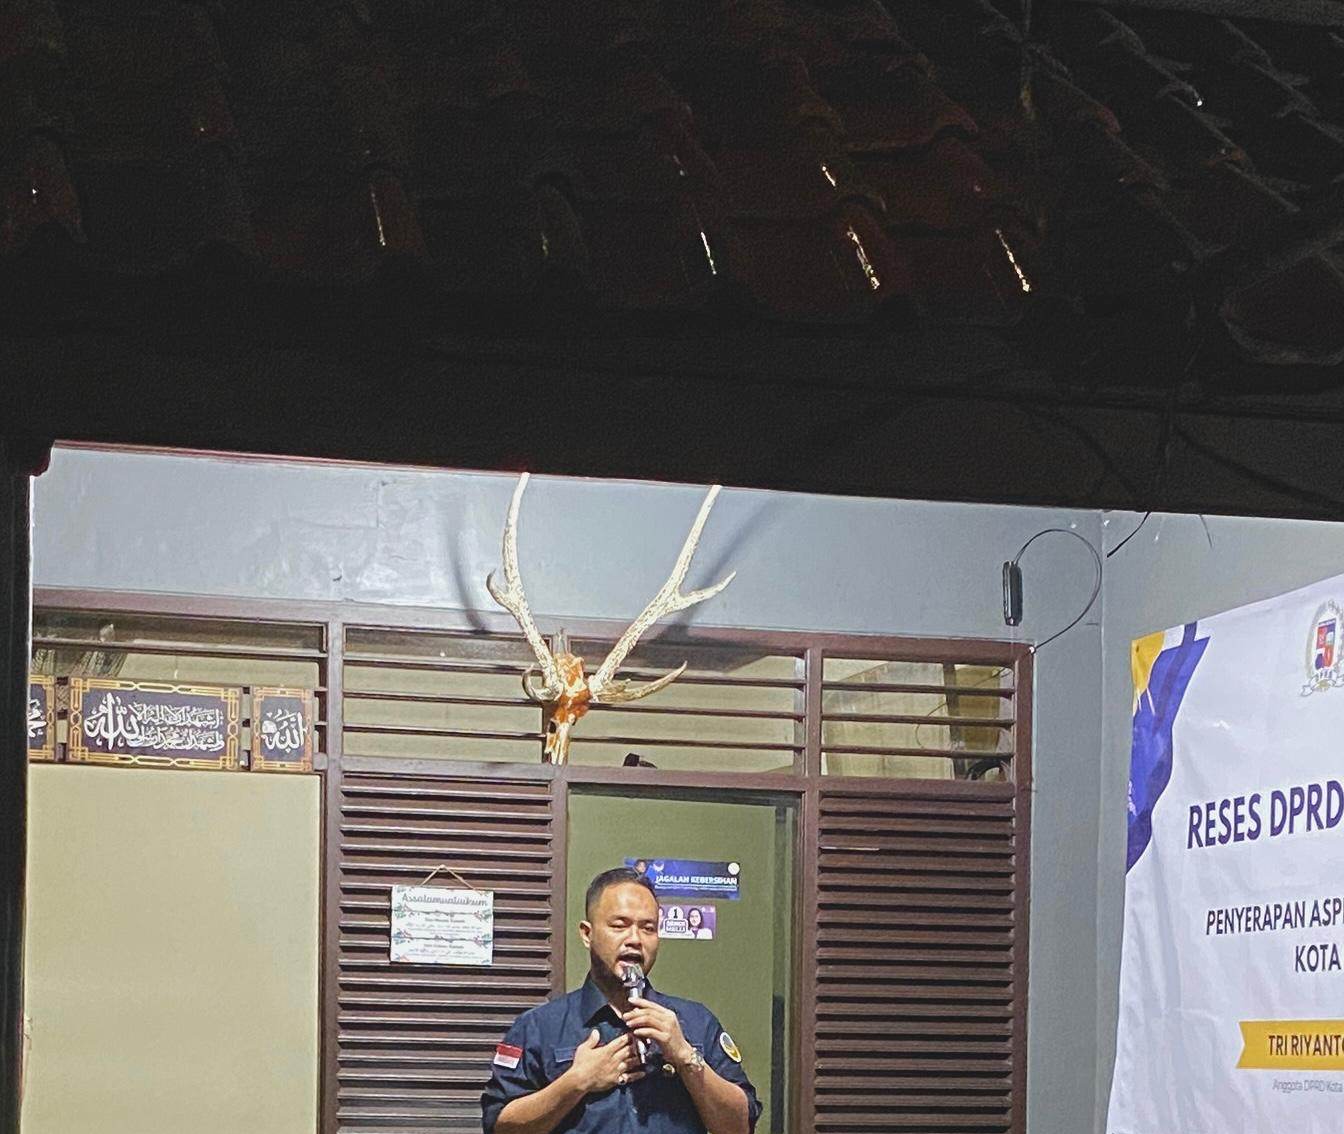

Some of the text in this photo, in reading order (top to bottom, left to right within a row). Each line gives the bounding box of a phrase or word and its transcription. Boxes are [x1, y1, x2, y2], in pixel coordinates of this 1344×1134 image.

[1187, 793, 1261, 849] RESES
[1270, 780, 1344, 837] DPRD
[1206, 900, 1306, 935] PENYERAPAN
[1295, 943, 1341, 972] KOTA
[1268, 1034, 1287, 1056] TRI
